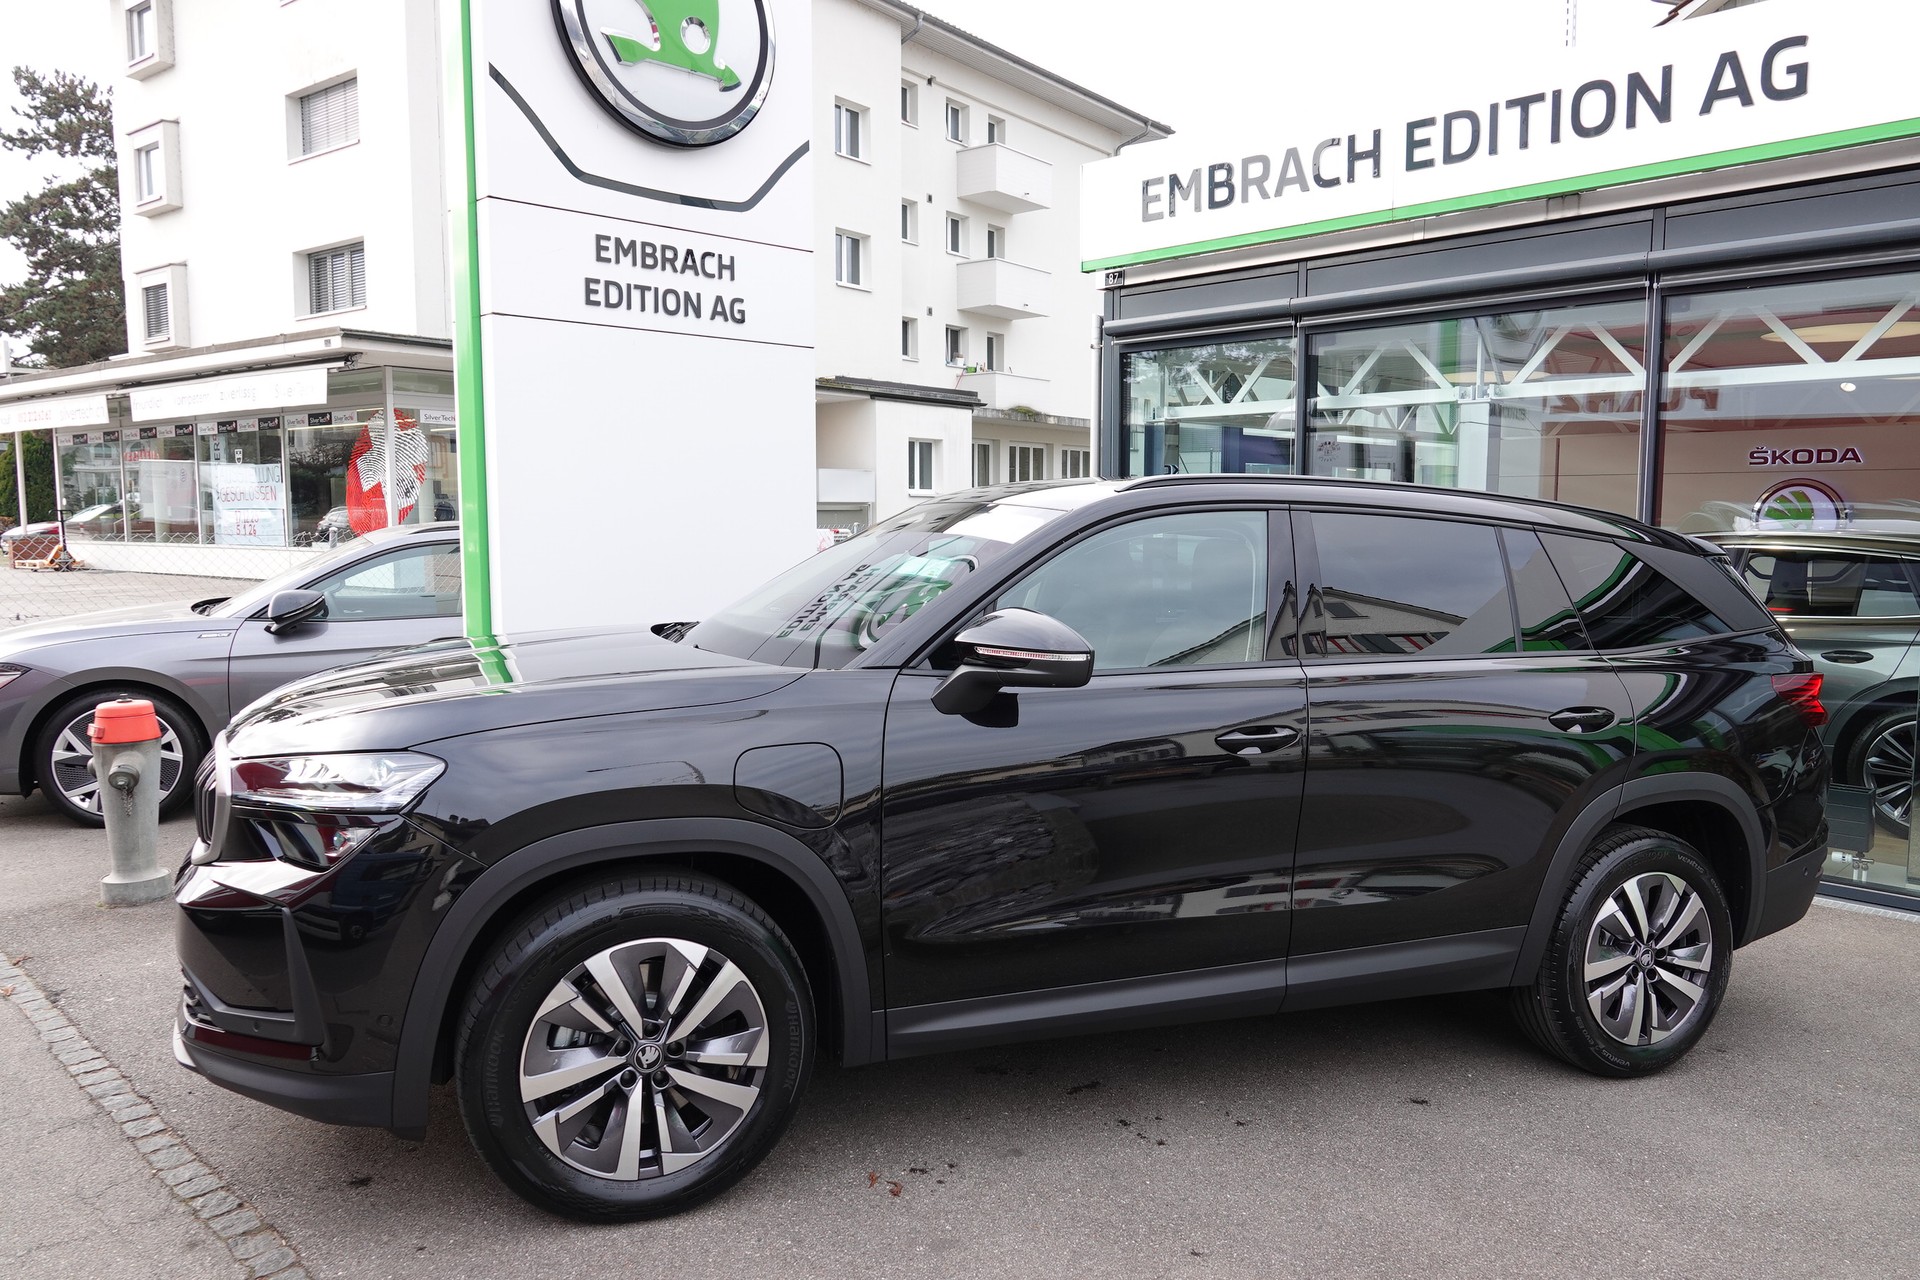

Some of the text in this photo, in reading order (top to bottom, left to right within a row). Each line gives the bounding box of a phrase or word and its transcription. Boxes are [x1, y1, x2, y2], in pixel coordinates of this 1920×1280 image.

[1141, 35, 1810, 223] EMBRACH EDITION AG
[595, 233, 736, 282] EMBRACH
[1108, 272, 1119, 284] 87
[584, 277, 746, 324] EDITION AG
[1748, 445, 1863, 466] ŠKODA
[220, 485, 277, 504] GESCHLOSSEN
